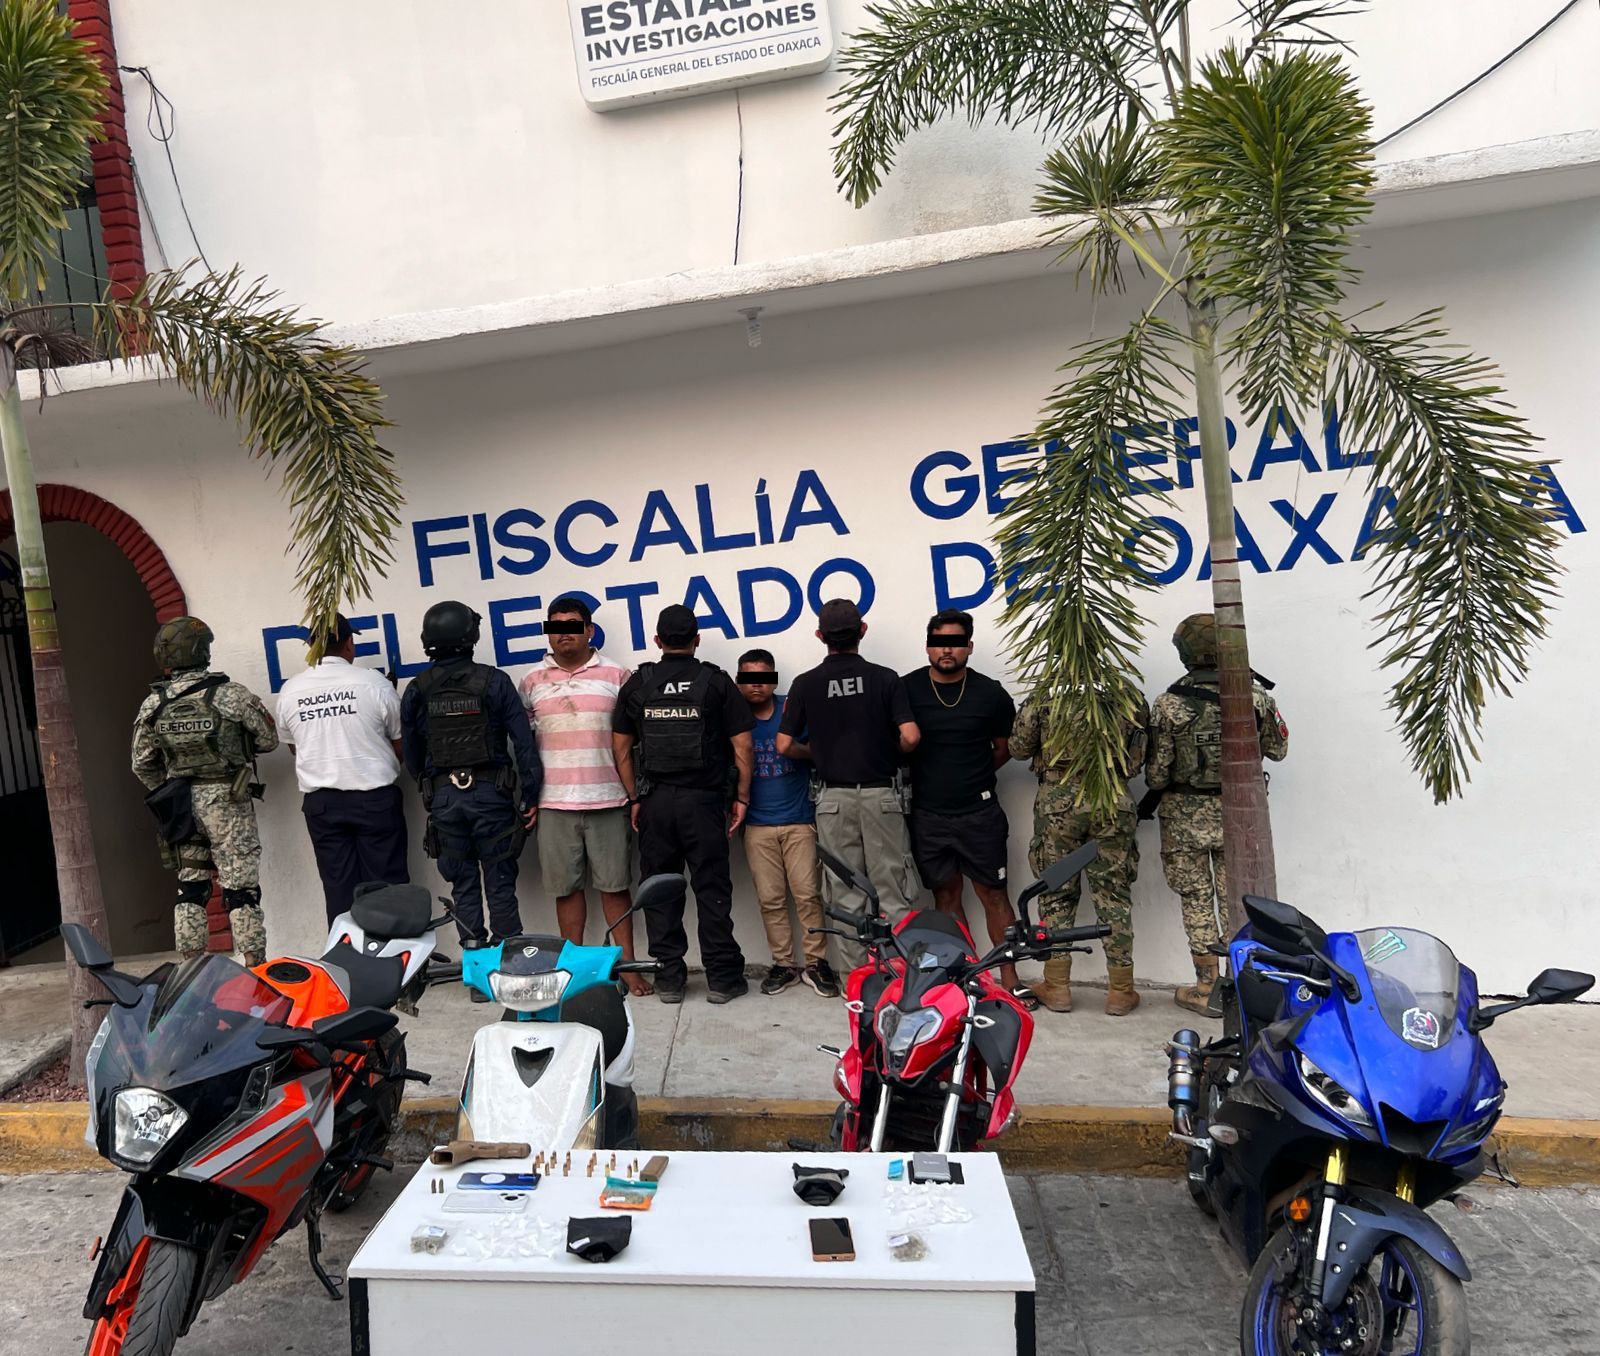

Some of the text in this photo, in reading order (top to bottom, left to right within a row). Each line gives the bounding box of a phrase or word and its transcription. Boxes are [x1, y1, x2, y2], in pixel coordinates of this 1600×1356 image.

[586, 3, 816, 62] INVESTIGACIONES
[591, 36, 821, 88] FISCALÍA GENERAL DEL ESTADO DE OAXACA
[411, 469, 850, 588] FISCALÍA
[1121, 465, 1588, 586] OAXAA
[664, 681, 693, 694] AF
[827, 676, 864, 698] AEI
[298, 690, 356, 707] POLICÍA VIAL
[300, 704, 357, 722] ESTATAL
[644, 708, 699, 719] FISCALIA
